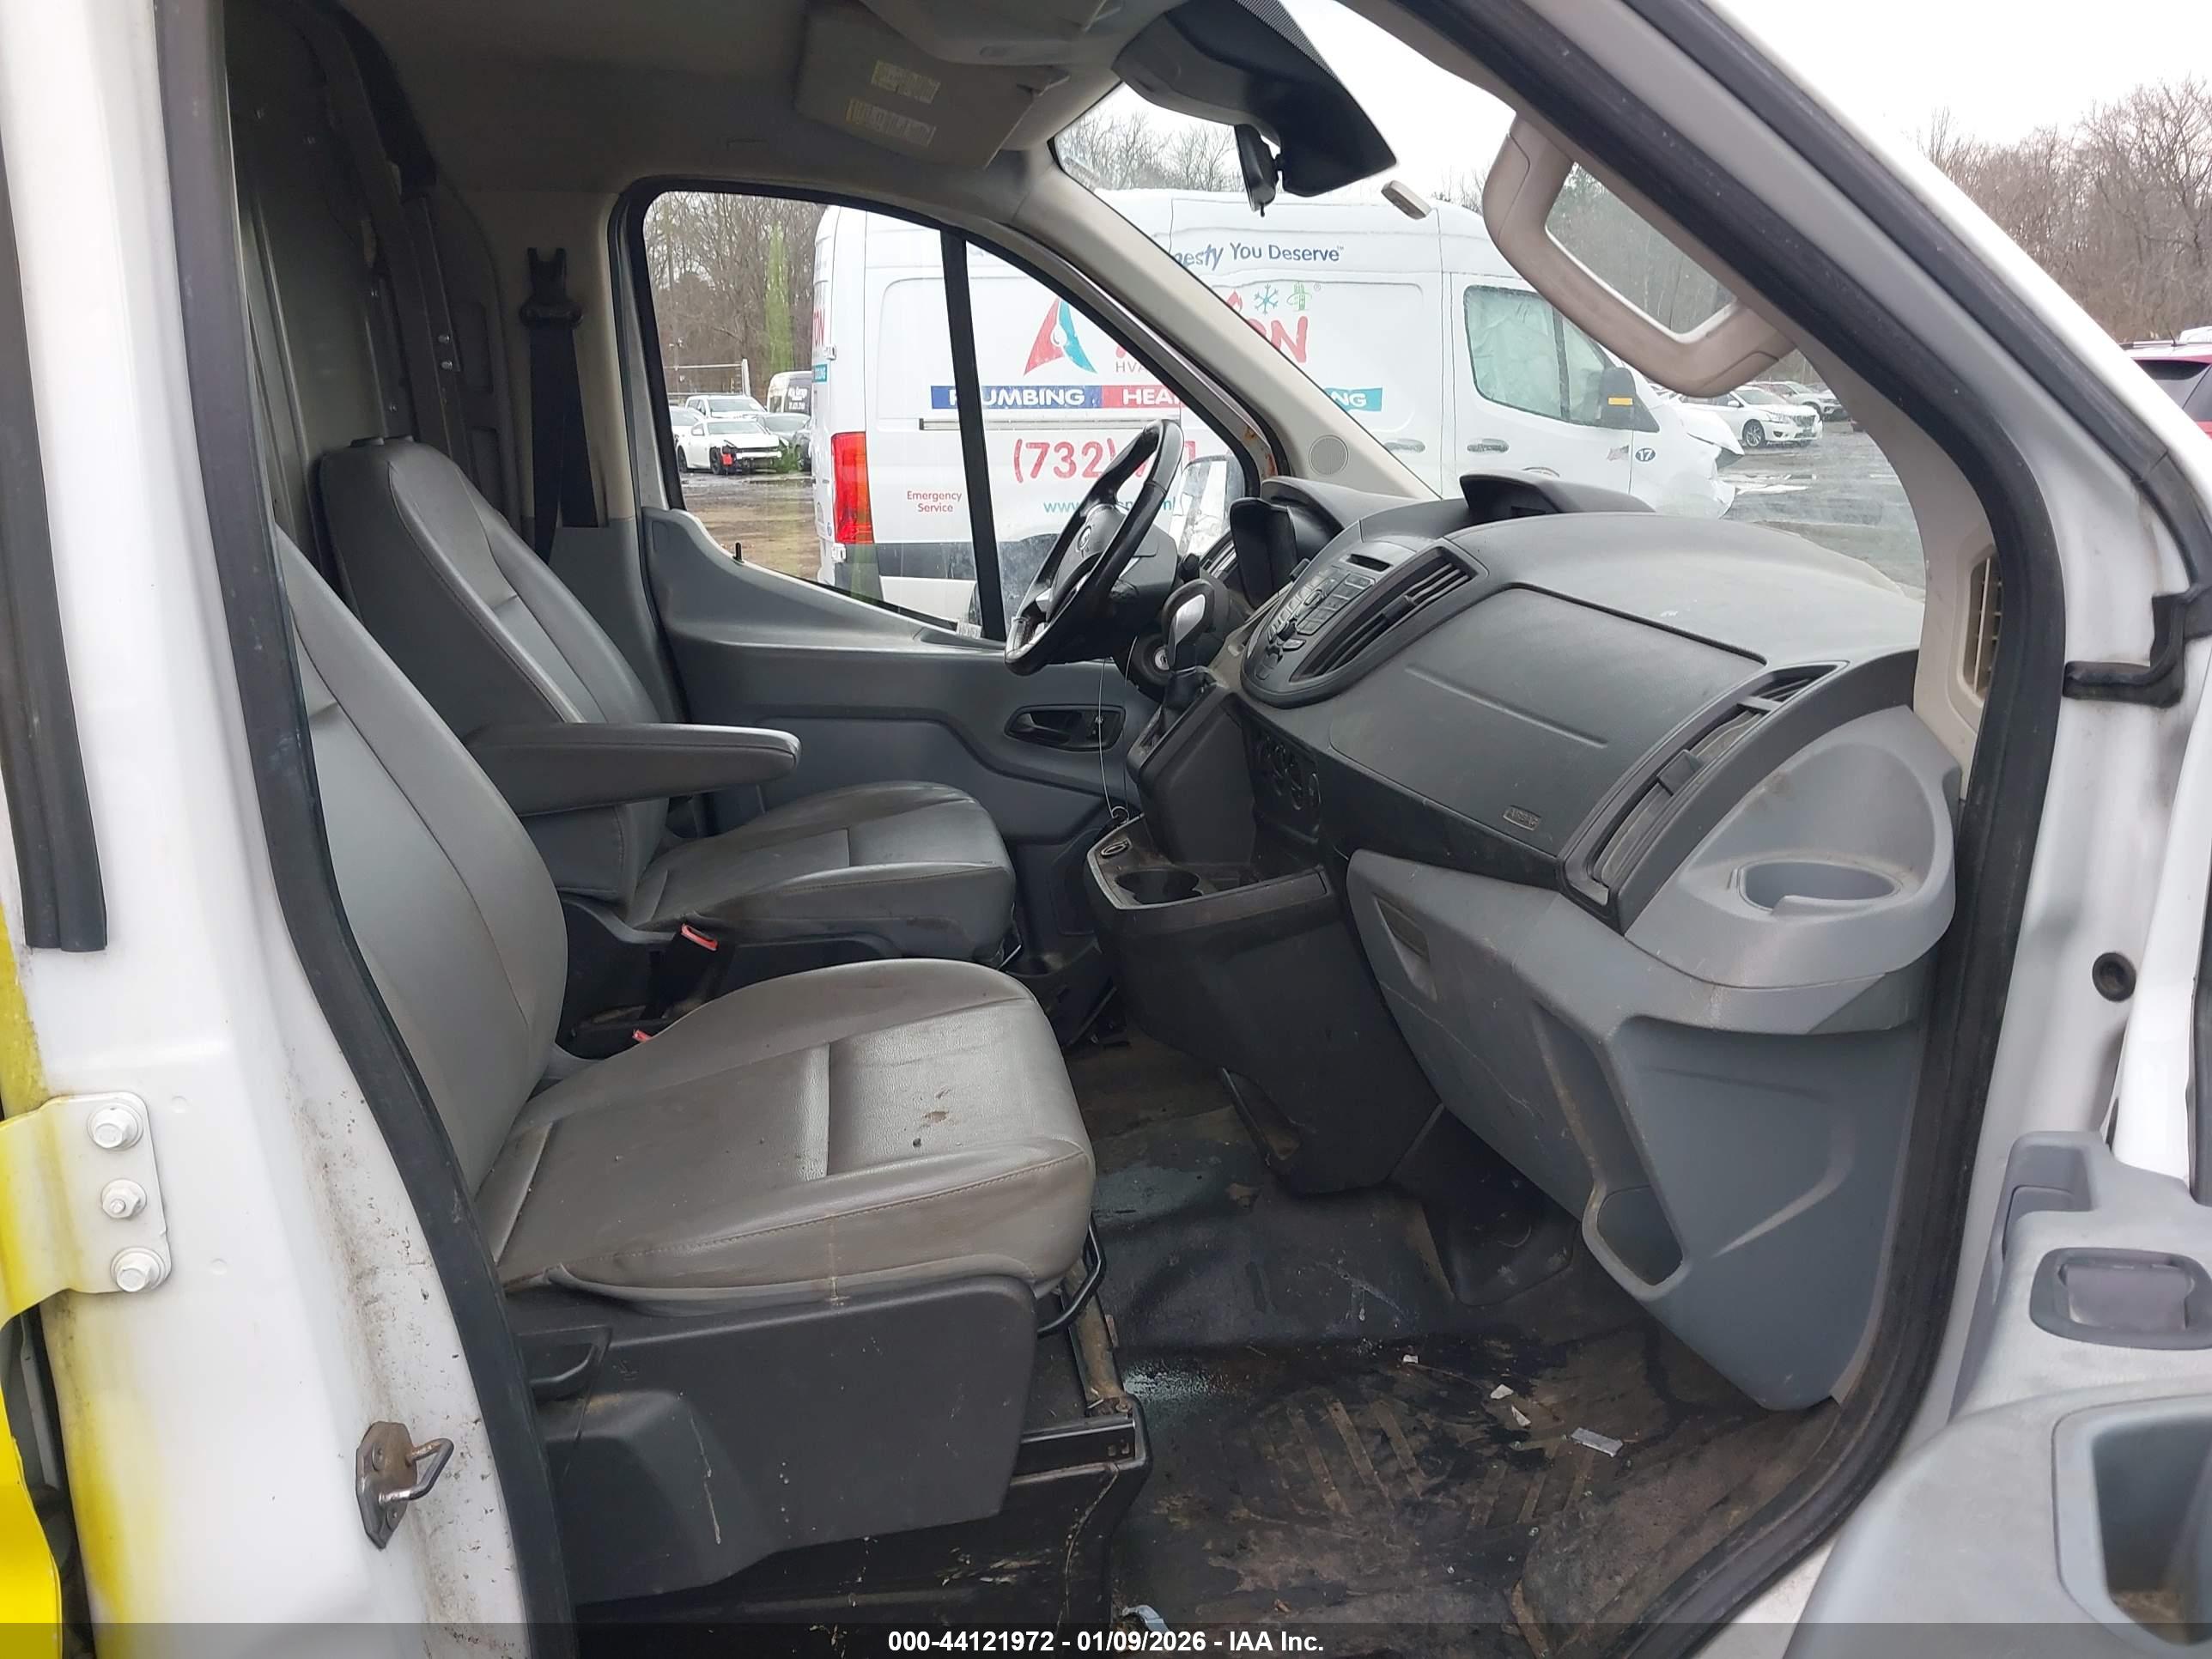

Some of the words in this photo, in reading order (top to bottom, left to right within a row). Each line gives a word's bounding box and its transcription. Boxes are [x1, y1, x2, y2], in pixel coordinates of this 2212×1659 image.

[1230, 242, 1262, 260] You
[949, 388, 1085, 406] UMBING
[907, 490, 963, 502] Emergency
[918, 502, 954, 513] Service
